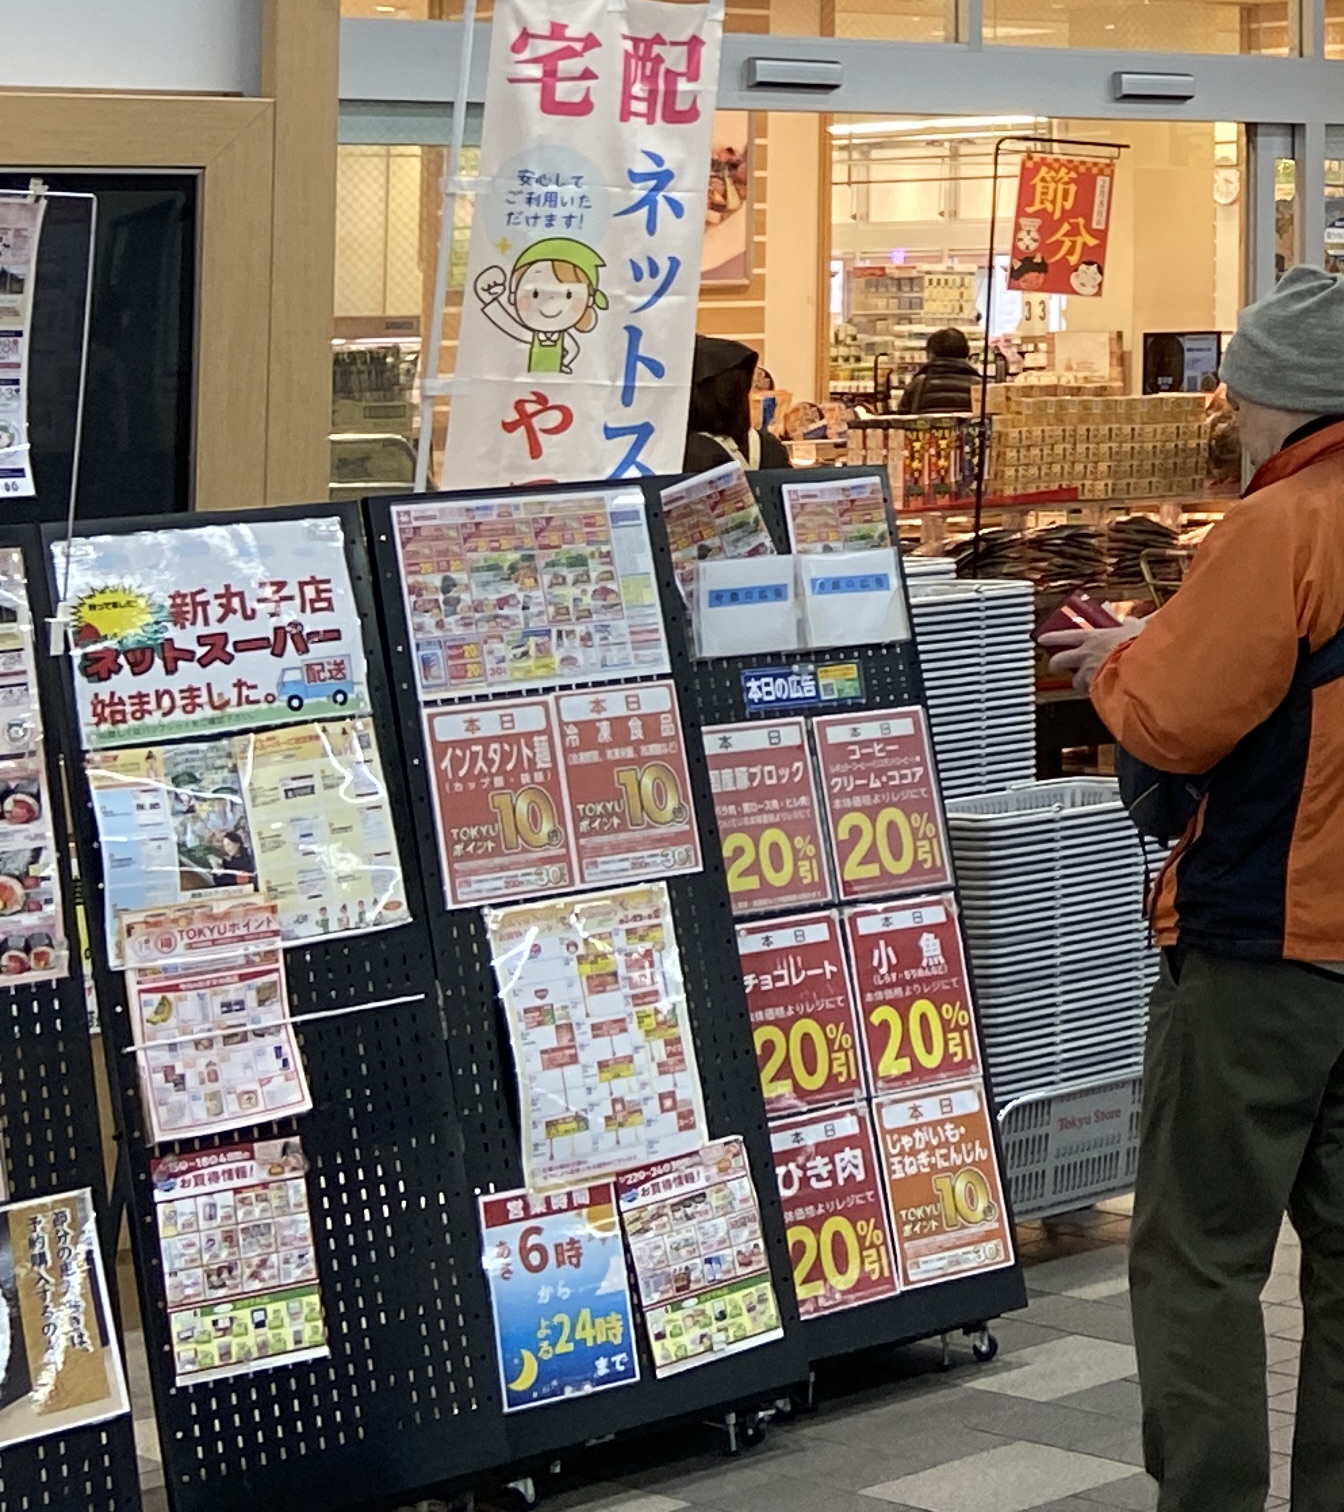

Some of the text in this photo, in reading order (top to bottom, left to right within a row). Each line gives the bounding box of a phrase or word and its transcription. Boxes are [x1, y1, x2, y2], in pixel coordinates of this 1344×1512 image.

[507, 22, 706, 125] 宅配
[517, 169, 584, 188] 安心して
[505, 190, 592, 209] ご利用いた
[1025, 166, 1099, 266] 節分
[168, 575, 336, 630] 新丸子店
[83, 622, 342, 681] ネットスーパー
[305, 660, 348, 684] 配送
[746, 674, 817, 702] 本日の広告
[90, 678, 278, 728] 始まりました。
[589, 695, 641, 715] 本日
[463, 713, 515, 734] 本日
[564, 713, 676, 748] 冷凍食品
[848, 722, 892, 738] 本日
[718, 729, 782, 750] 本日
[847, 742, 899, 760] コーヒー
[440, 735, 552, 779] インスタント麺
[830, 767, 924, 793] クリーム・ココア
[576, 799, 625, 817] TOKYU
[450, 823, 499, 841] TOKYU
[579, 816, 622, 834] ポイント
[453, 840, 496, 857] ポイント
[880, 911, 923, 928] 本日
[761, 929, 806, 948] 本日
[872, 932, 945, 975] 小魚
[743, 955, 838, 993] チョコレート
[864, 977, 960, 1002] 本体価格よりレジにて
[907, 1097, 953, 1121] 本日
[1058, 1107, 1121, 1132] Tokyu Store
[791, 1123, 836, 1144] 本日
[888, 1140, 988, 1179] 玉ねぎ・にんじん
[775, 1146, 866, 1199] ひき肉
[506, 1187, 591, 1221] 営業時間
[518, 1225, 583, 1273] 6時
[537, 1280, 571, 1304] から
[553, 1307, 623, 1354] 24時
[594, 1352, 629, 1376] まで
